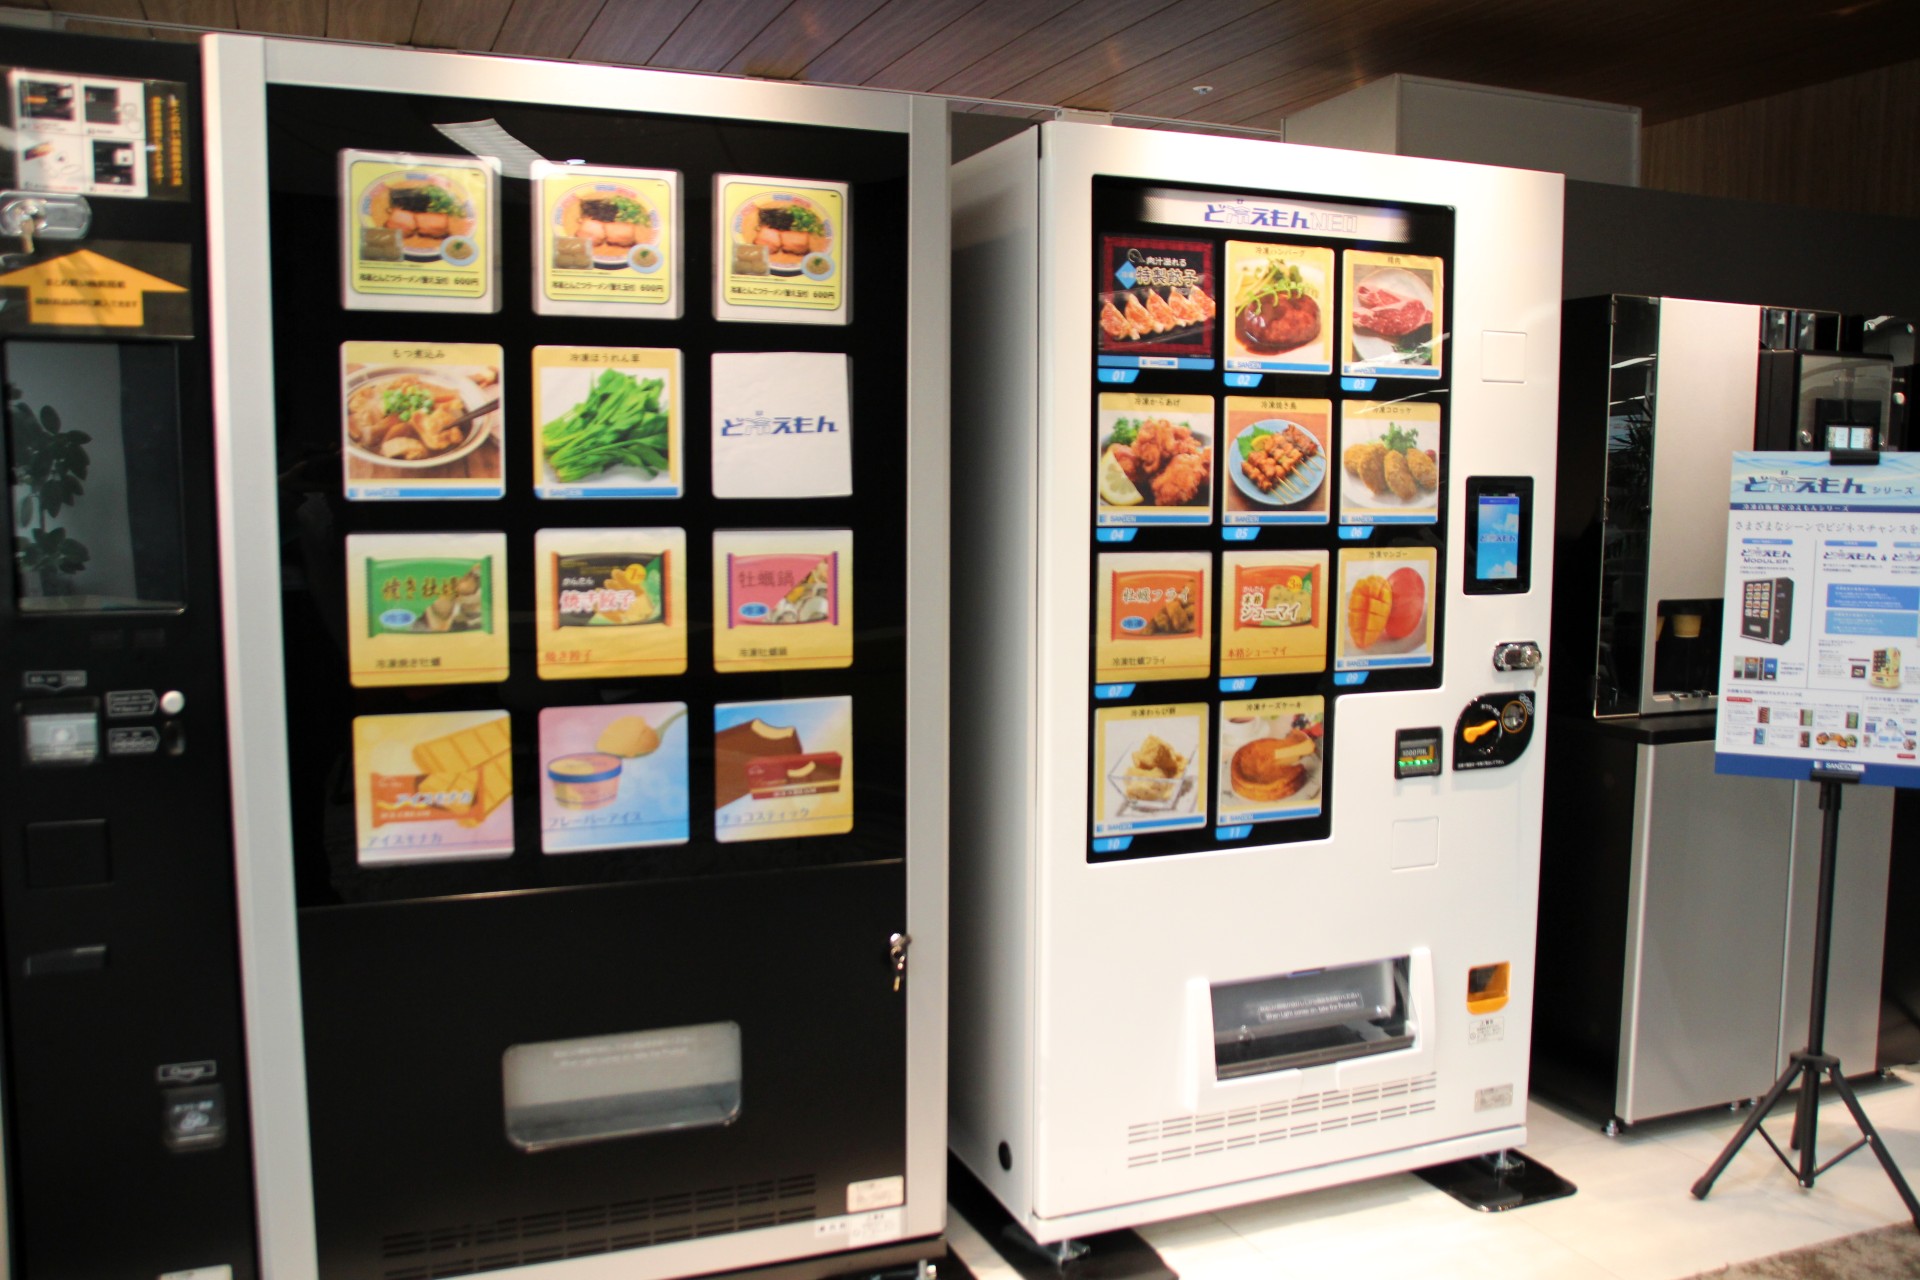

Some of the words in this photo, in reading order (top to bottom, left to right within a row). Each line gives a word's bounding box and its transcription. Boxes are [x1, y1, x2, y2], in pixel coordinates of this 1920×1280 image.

[1136, 266, 1199, 287] 特製餃子
[393, 349, 446, 359] もつ煮込み
[570, 352, 641, 363] 冷凍ほうれん草
[1112, 370, 1126, 382] 01
[1237, 375, 1251, 386] 02
[1135, 397, 1181, 407] 冷凍からあげ
[1260, 401, 1297, 410] 冷凍焼き鳥
[1872, 486, 1914, 495] シリーズ
[1110, 529, 1125, 541] 04
[1235, 528, 1249, 539] 05
[1122, 586, 1190, 604] 牡蠣フライ
[1240, 602, 1303, 622] シューマイ
[1112, 656, 1167, 667] 冷凍牡蠣フライ
[1232, 679, 1246, 691] 08
[1108, 685, 1123, 697] 07
[1246, 702, 1302, 712] 冷凍チーズケーキ
[551, 812, 642, 828] フレーバーアイス
[1108, 838, 1121, 849] 10
